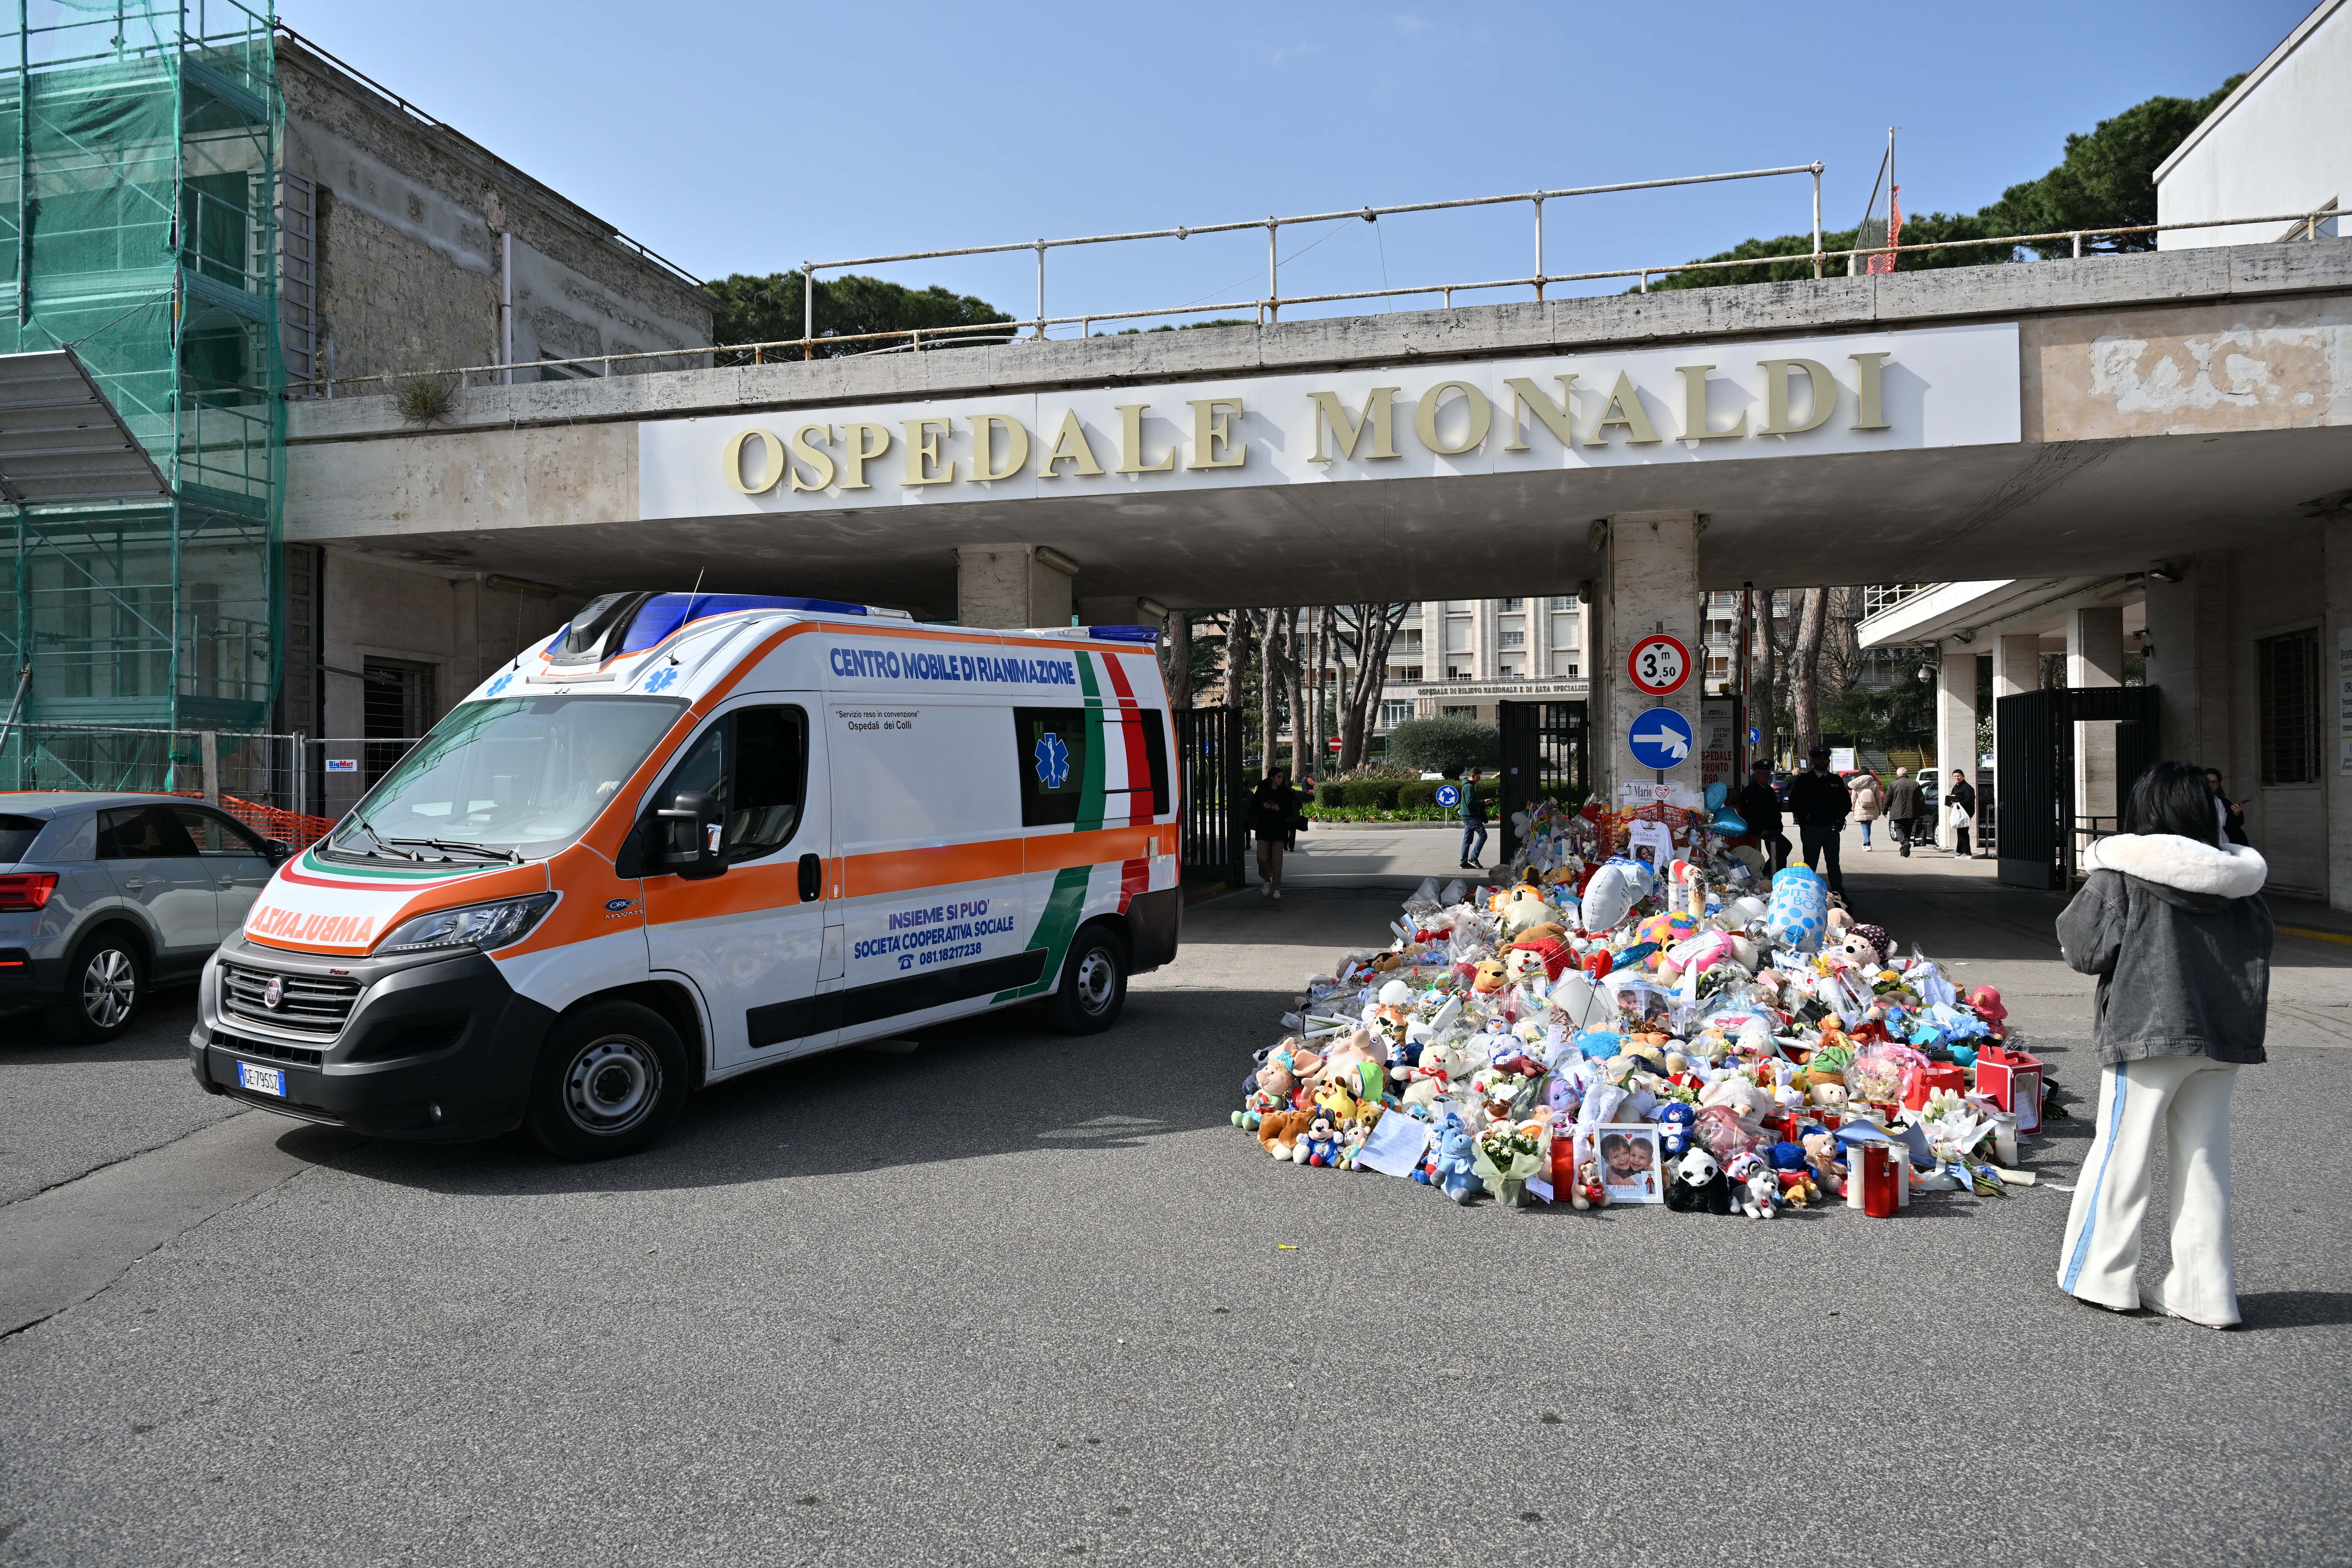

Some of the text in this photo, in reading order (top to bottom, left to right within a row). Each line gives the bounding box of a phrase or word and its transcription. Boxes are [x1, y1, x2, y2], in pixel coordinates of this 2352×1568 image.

[722, 352, 1892, 495] OSPEDALE MONALDI
[830, 648, 1076, 684] CENTRO MOBILE DI RIANIMAZIONE
[848, 721, 912, 732] Ospedali dei Colli
[1701, 751, 1732, 761] SPEDALE
[1702, 762, 1728, 772] PRONTO
[1634, 786, 1652, 797] Mario
[610, 898, 641, 908] ORION
[1794, 896, 1822, 913] BOY
[889, 906, 944, 930] INSIEME
[946, 904, 958, 921] SI
[902, 925, 972, 950] COOPERATIVA
[974, 916, 1014, 936] SOCIALE
[919, 942, 982, 965] 081.18217238
[267, 986, 279, 1001] FIAT
